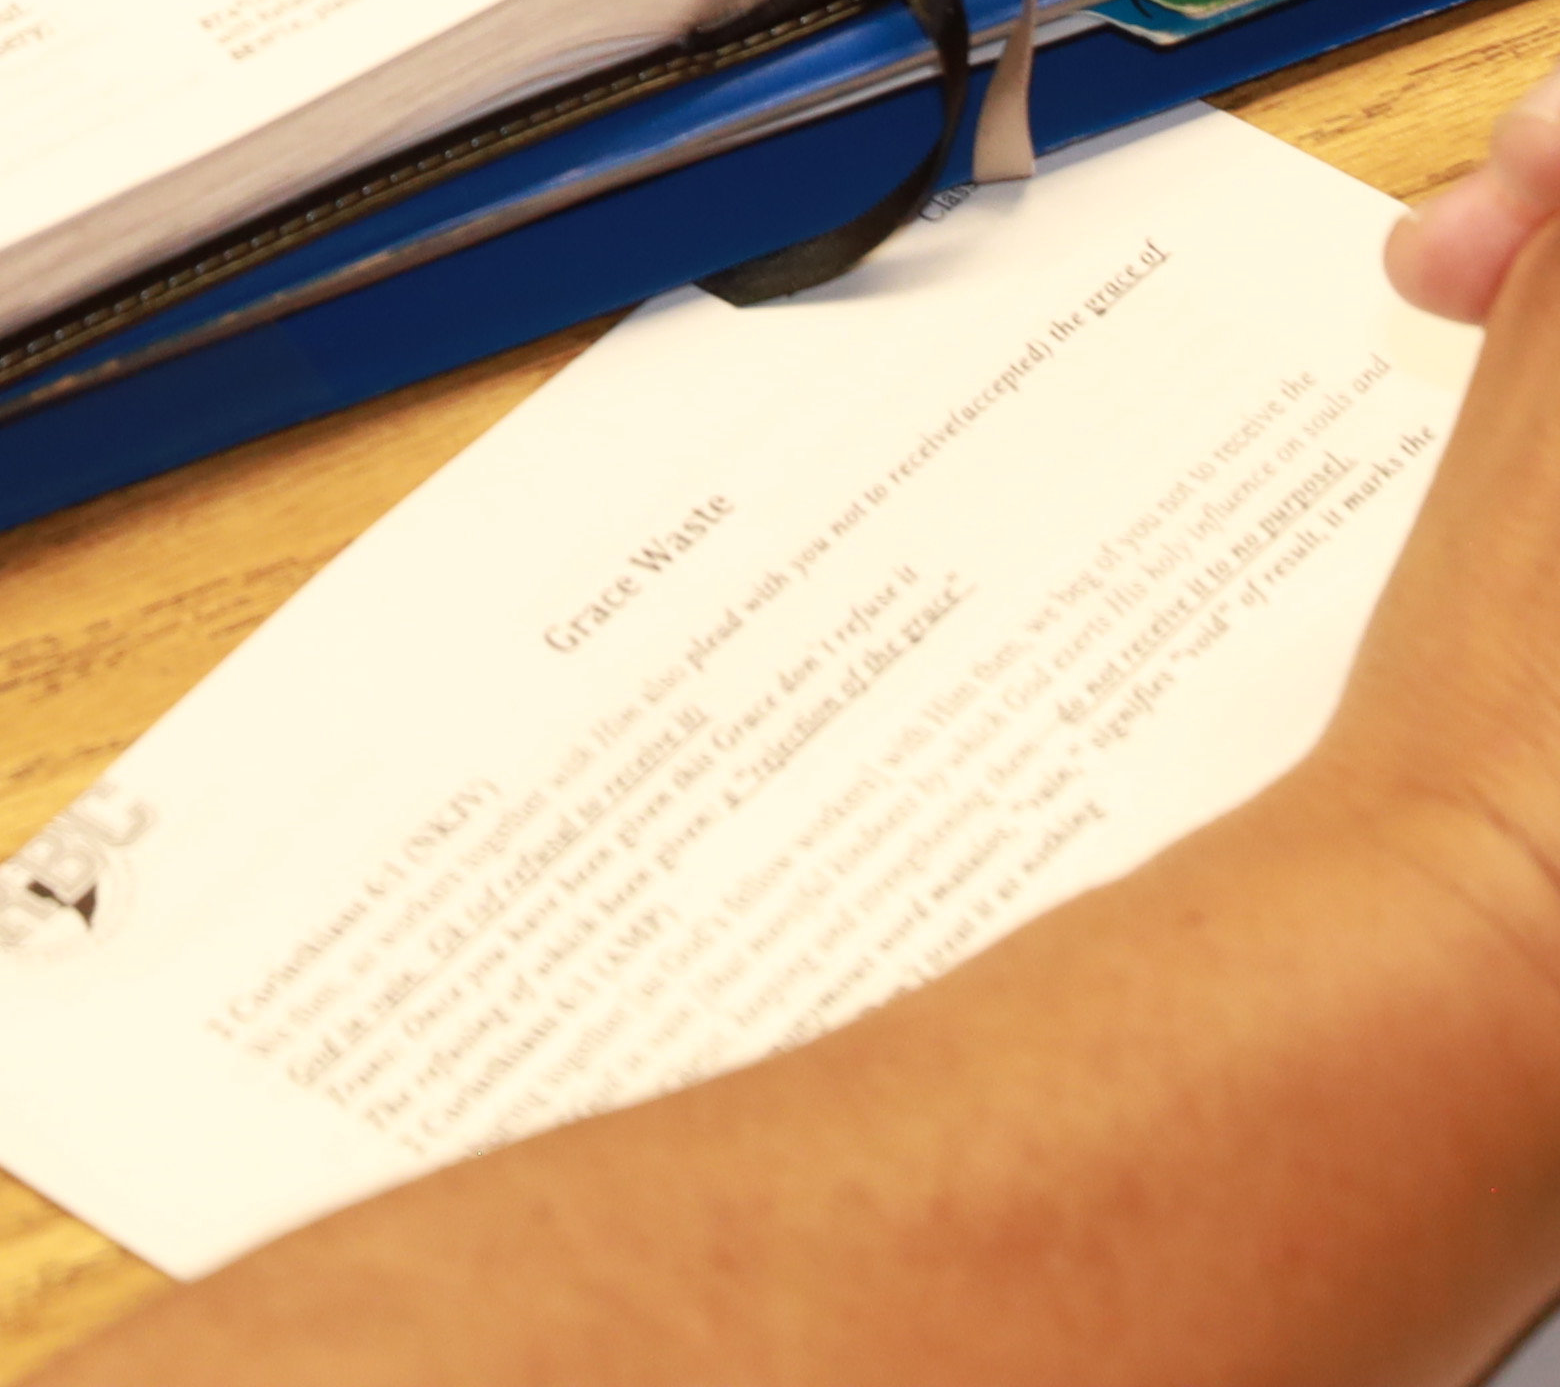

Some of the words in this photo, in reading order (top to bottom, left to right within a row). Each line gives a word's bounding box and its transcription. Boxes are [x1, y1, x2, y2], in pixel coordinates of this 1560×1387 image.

[685, 608, 743, 671] plead
[743, 570, 791, 615] with
[791, 537, 832, 579] you
[829, 500, 868, 535] not
[865, 481, 888, 506] to
[1049, 308, 1086, 344] the
[1086, 262, 1139, 319] grace
[1137, 236, 1170, 268] of
[1240, 581, 1270, 611] of
[1323, 508, 1344, 529] it
[1342, 454, 1404, 513] marks
[1400, 425, 1438, 460] the
[542, 571, 641, 656] Grace
[628, 491, 734, 576] Waste
